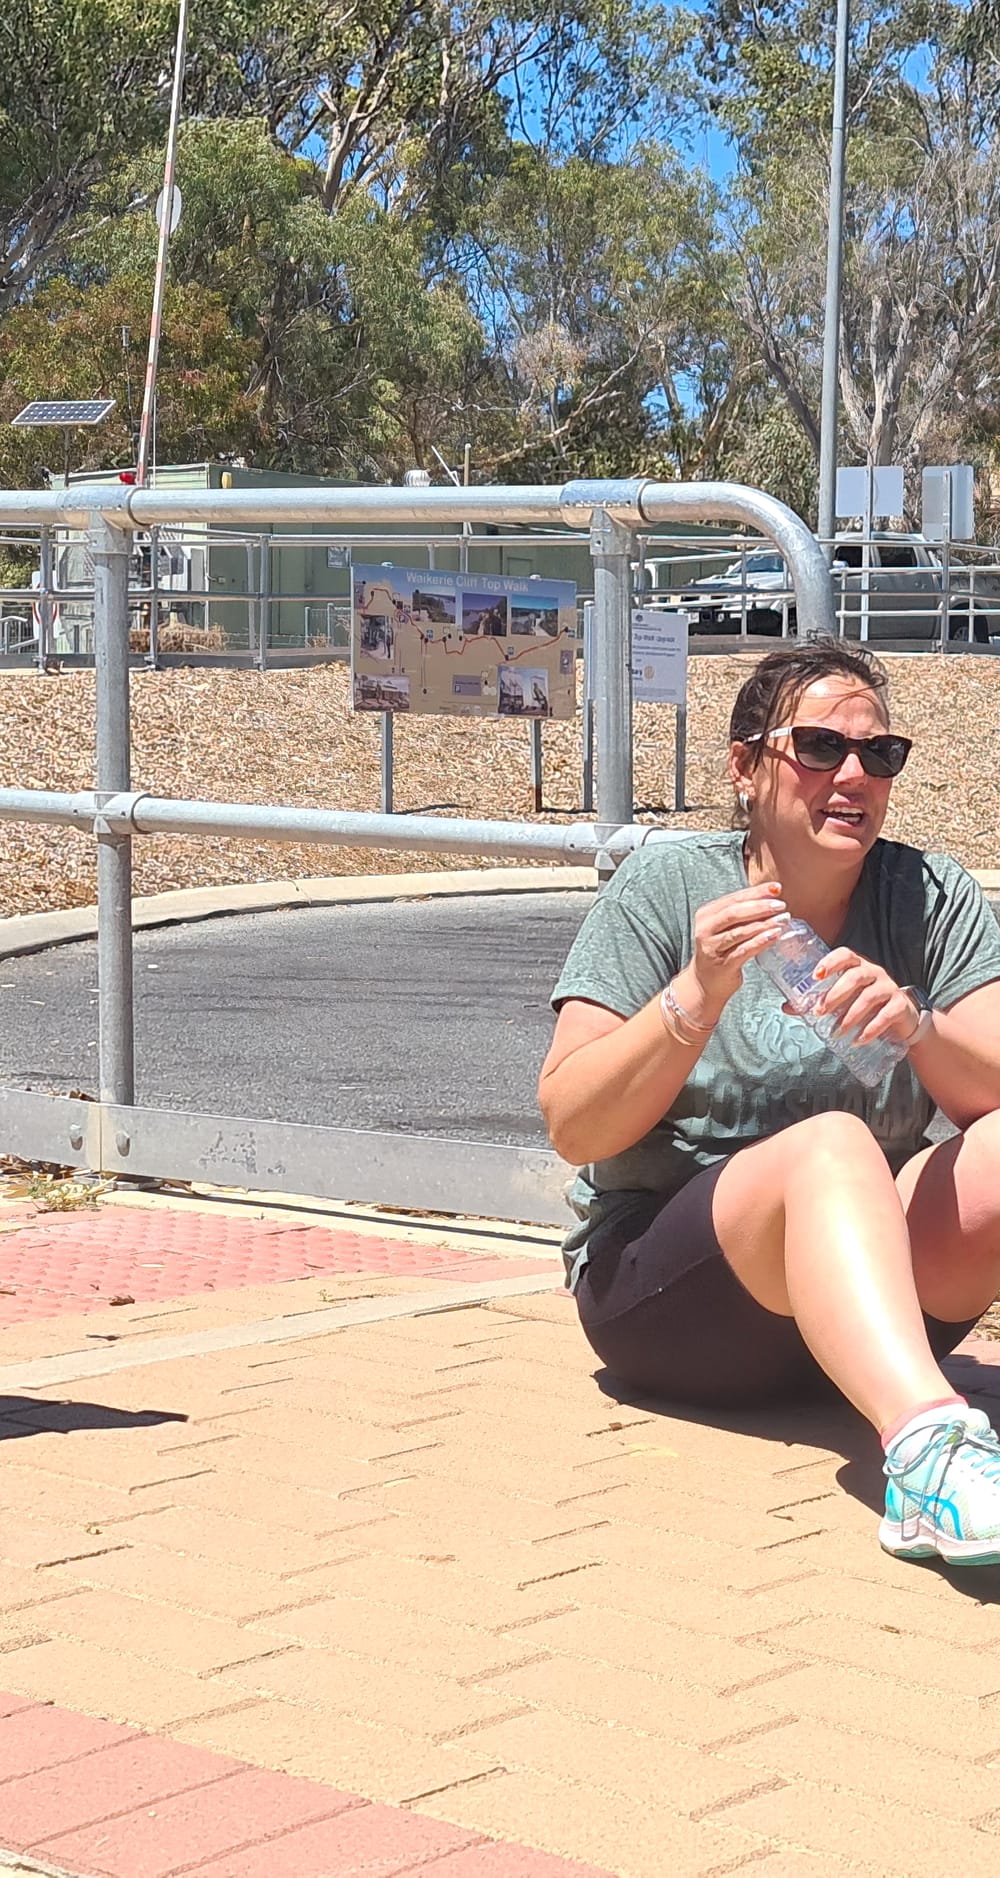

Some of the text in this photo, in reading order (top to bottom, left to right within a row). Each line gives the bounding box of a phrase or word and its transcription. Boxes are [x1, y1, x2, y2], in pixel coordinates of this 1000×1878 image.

[406, 571, 529, 592] Waikerie Cliff Top Walk
